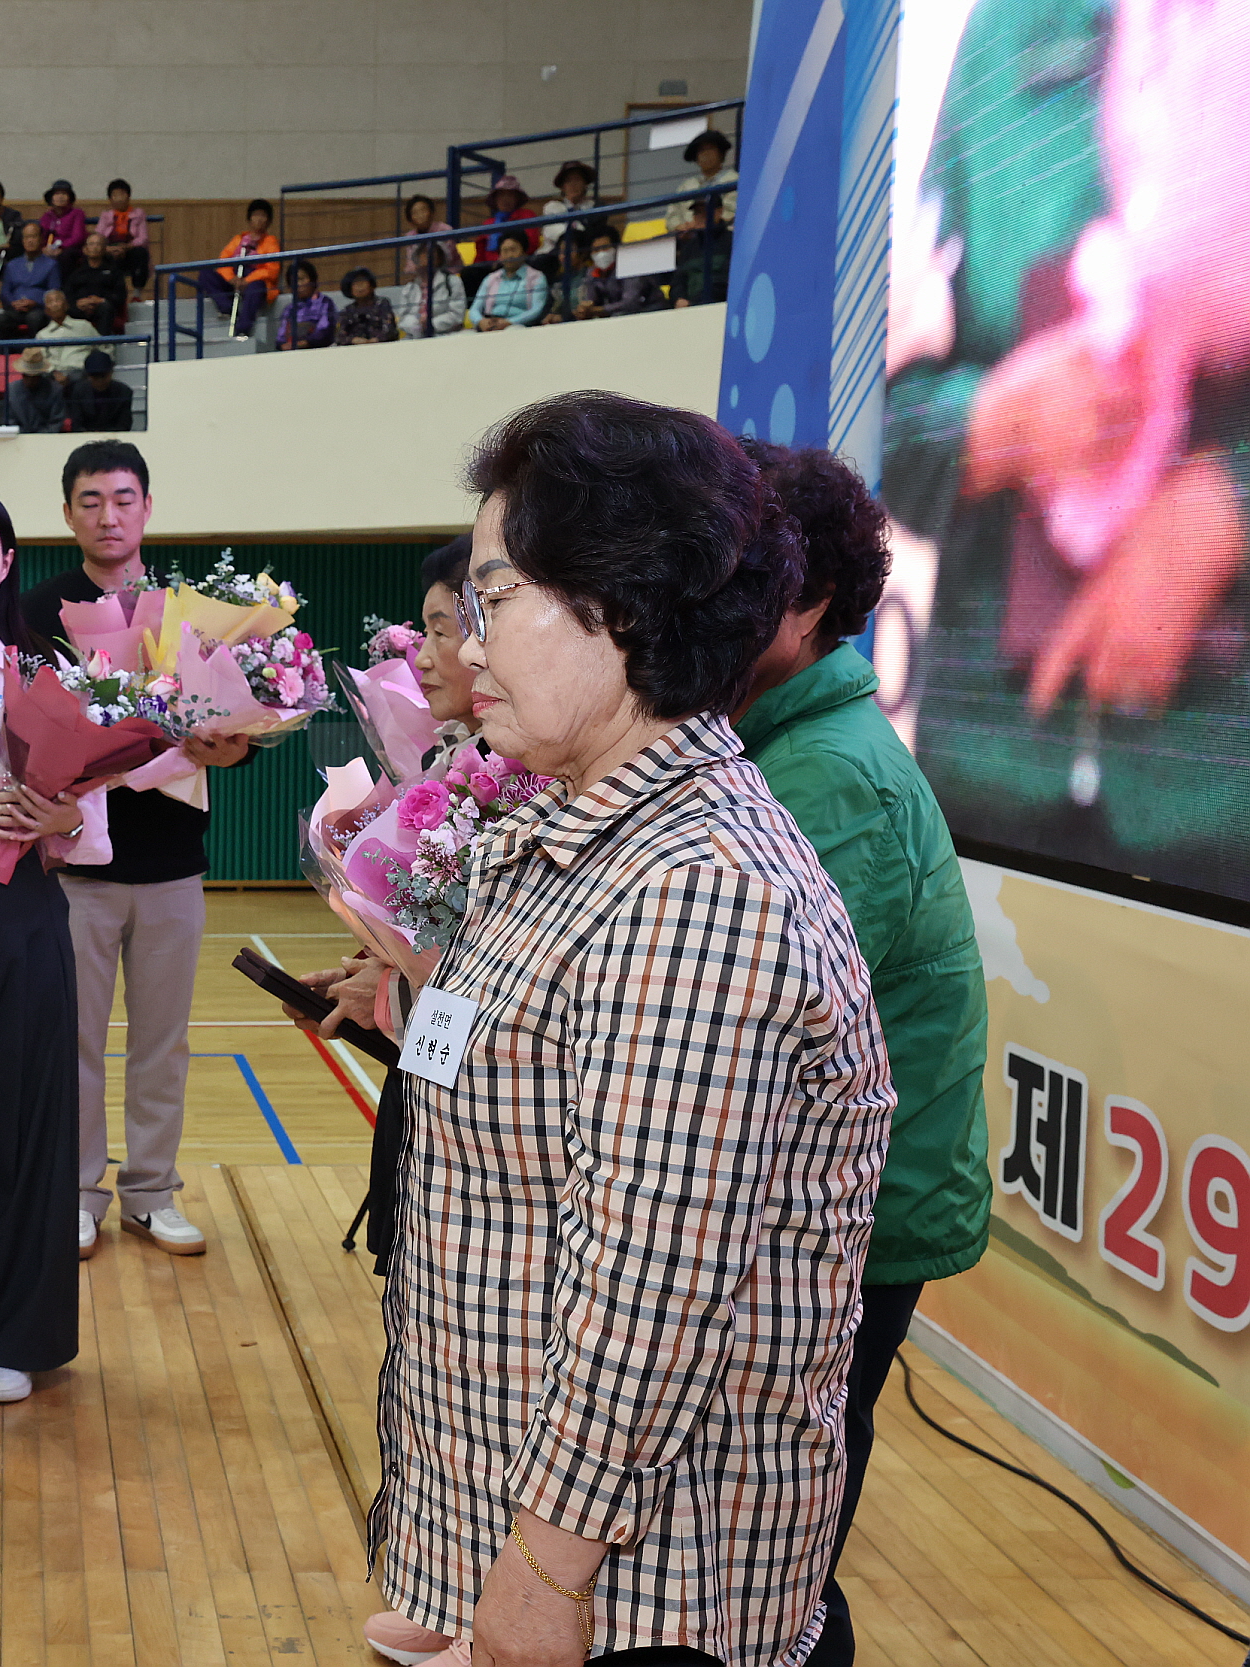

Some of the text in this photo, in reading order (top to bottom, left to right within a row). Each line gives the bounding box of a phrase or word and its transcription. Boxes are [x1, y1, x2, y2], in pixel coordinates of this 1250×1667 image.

[431, 1009, 453, 1030] 설천면
[415, 1034, 450, 1066] 신현순
[1001, 1048, 1250, 1326] 제29
